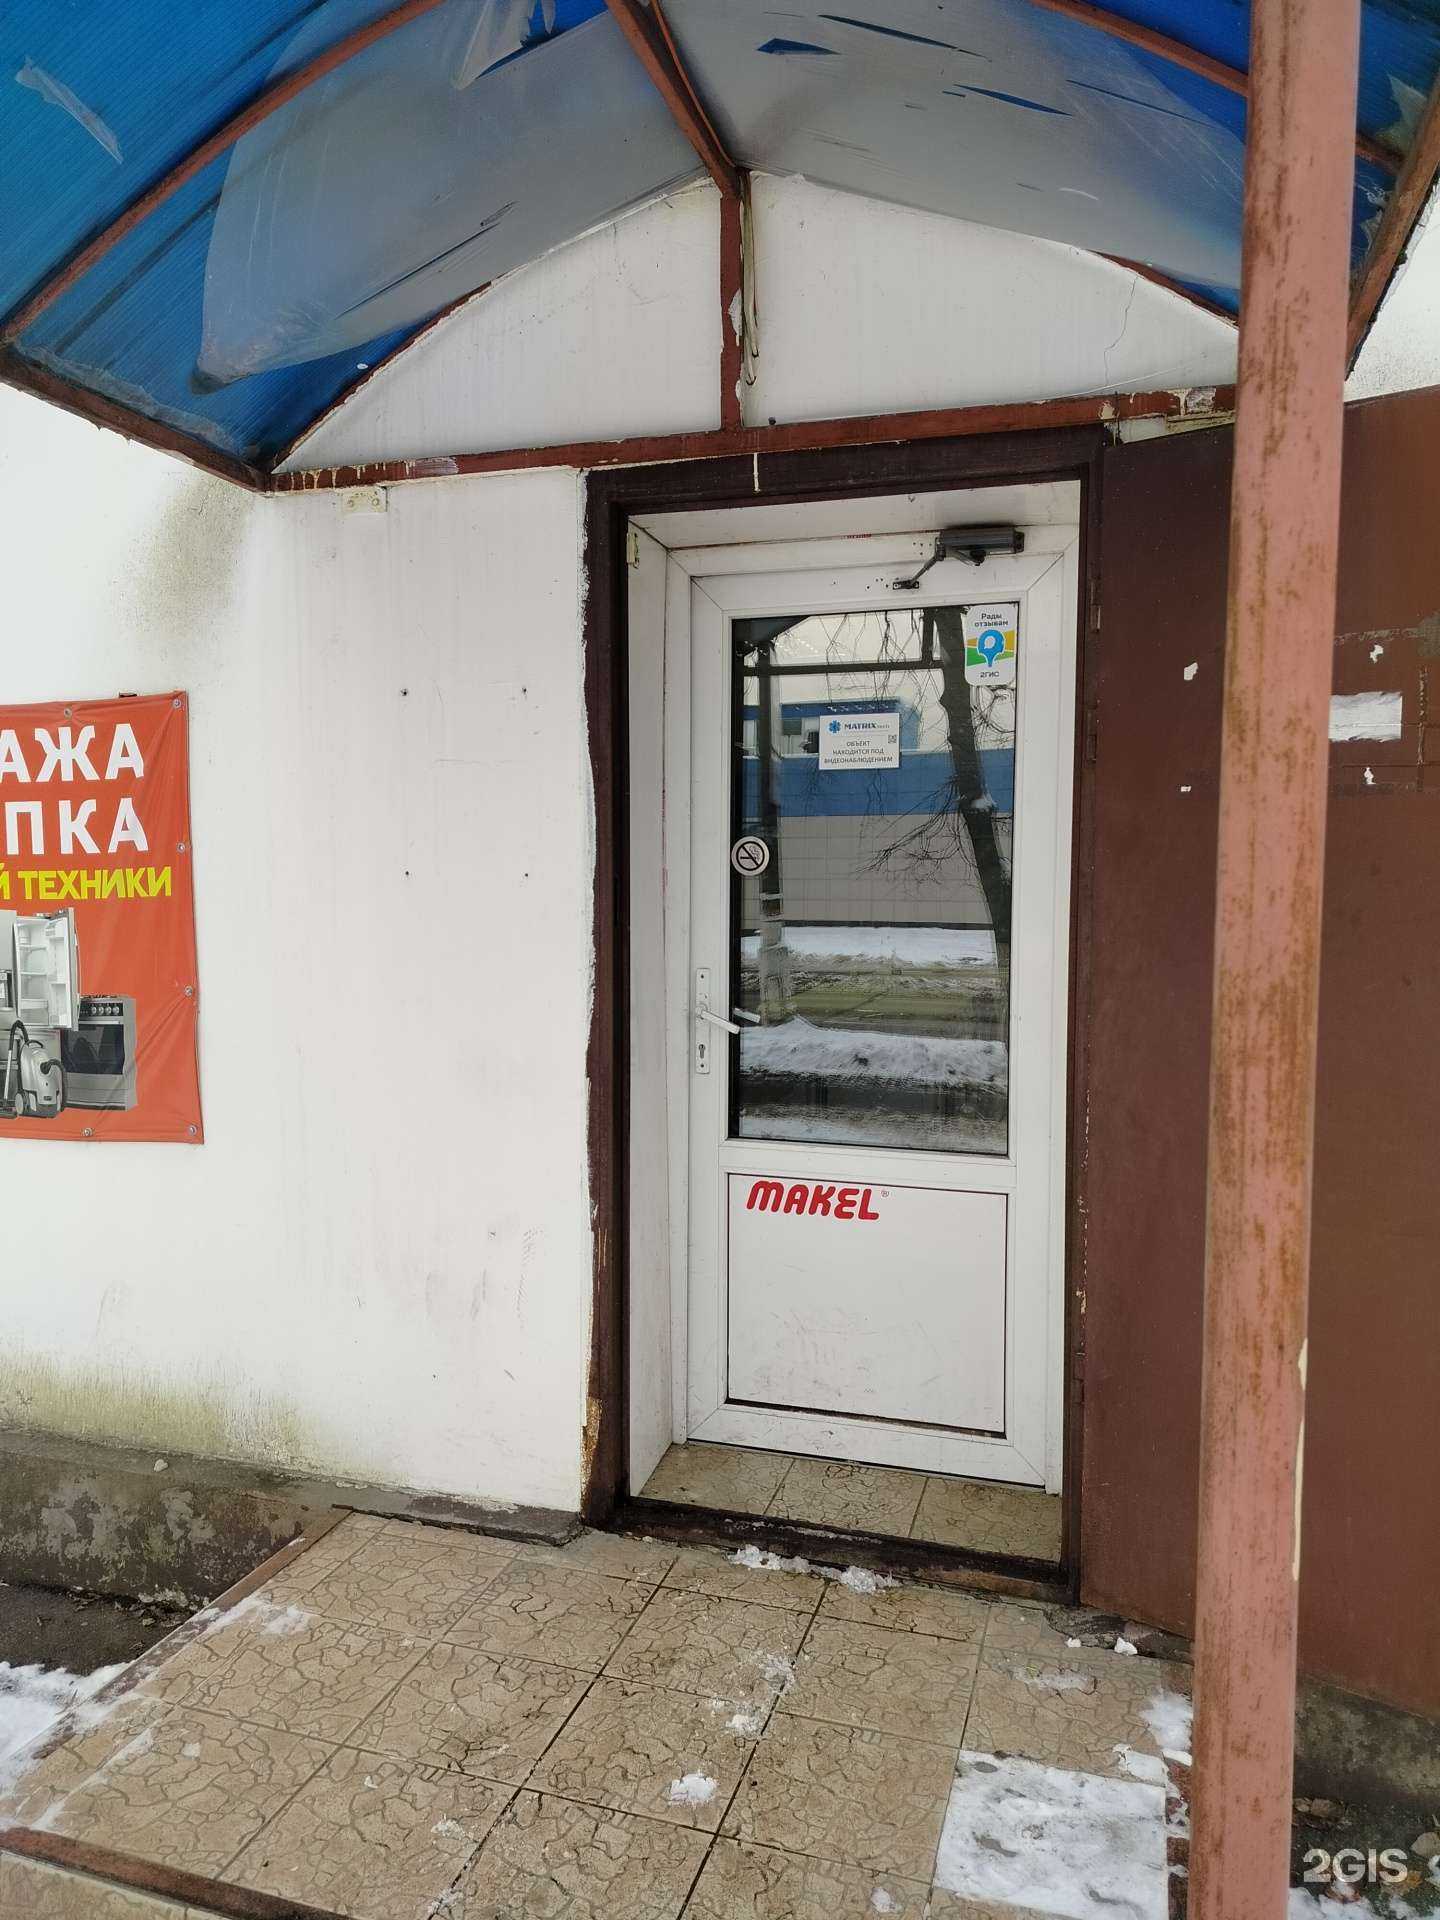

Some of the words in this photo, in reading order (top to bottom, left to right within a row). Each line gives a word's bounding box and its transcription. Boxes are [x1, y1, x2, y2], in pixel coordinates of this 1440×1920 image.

[844, 722, 876, 730] MATRIX
[4, 798, 149, 855] ПКА
[17, 866, 172, 901] ТЕХНИКИ
[746, 1180, 880, 1221] MAKEL
